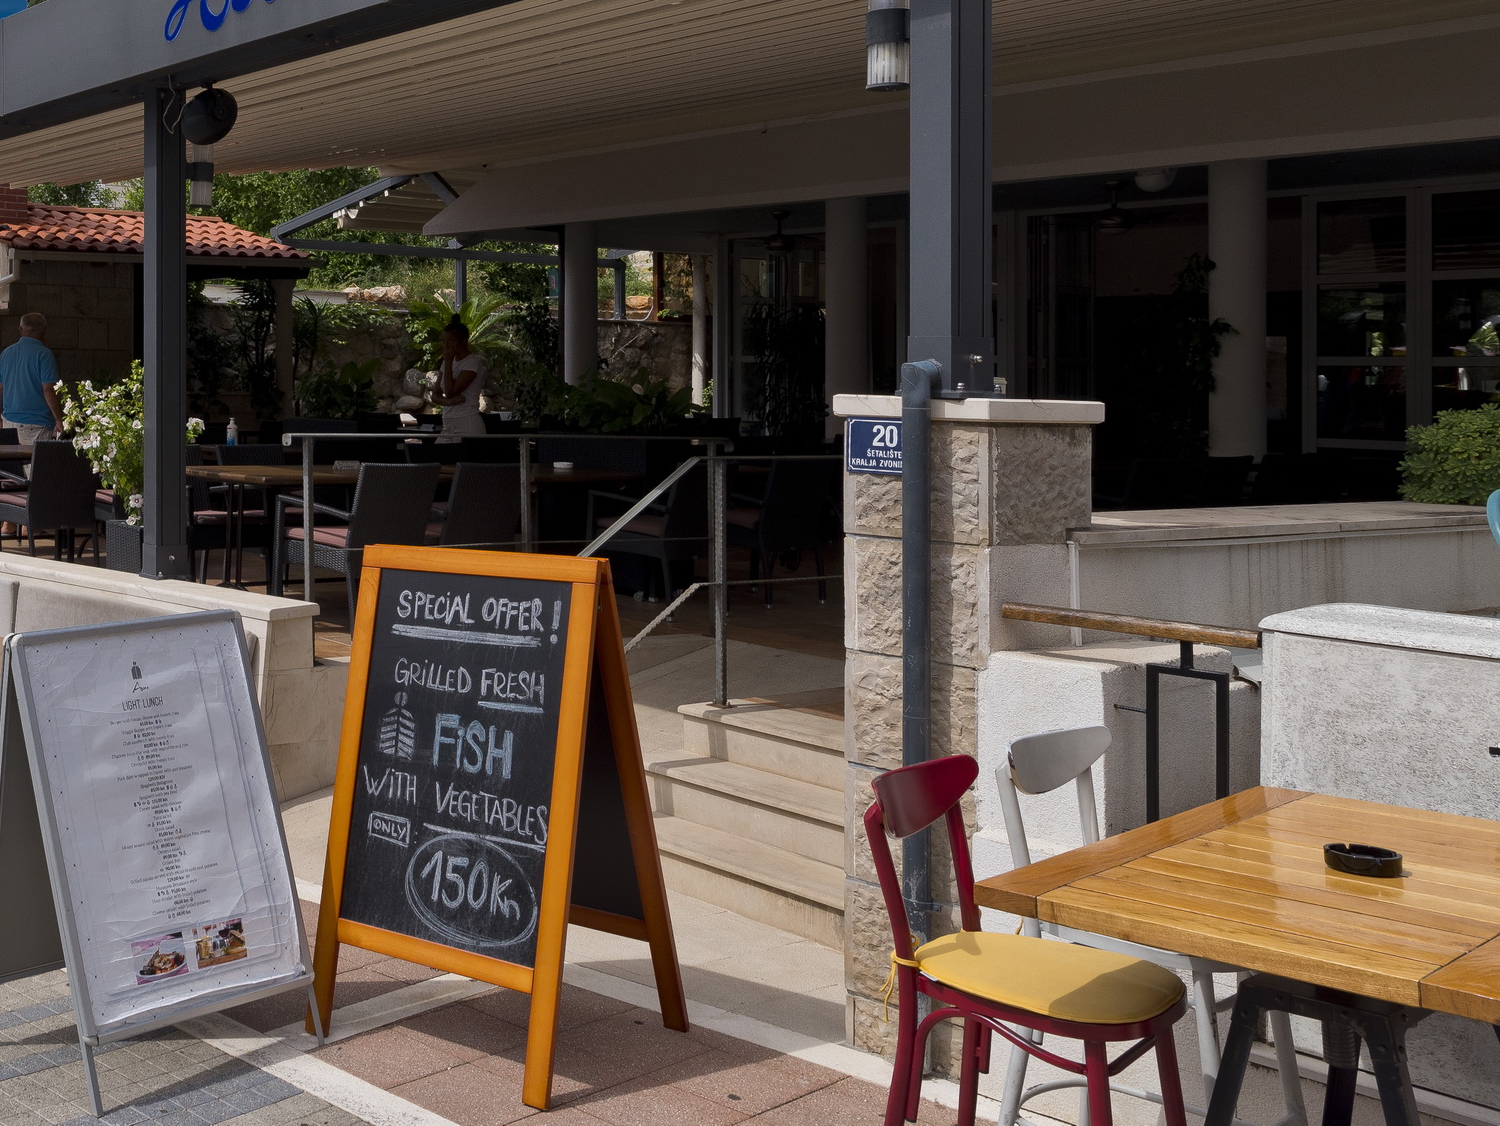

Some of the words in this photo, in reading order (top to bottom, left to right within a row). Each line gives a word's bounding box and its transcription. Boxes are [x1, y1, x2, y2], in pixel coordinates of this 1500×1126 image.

[872, 424, 898, 447] 20
[852, 458, 877, 466] KRALJA
[867, 448, 902, 459] ŠETALIŠTE
[481, 668, 544, 704] FRESH
[122, 699, 141, 711] LIGHT
[142, 696, 164, 708] LUNCH
[436, 782, 547, 844] VEGETABLES
